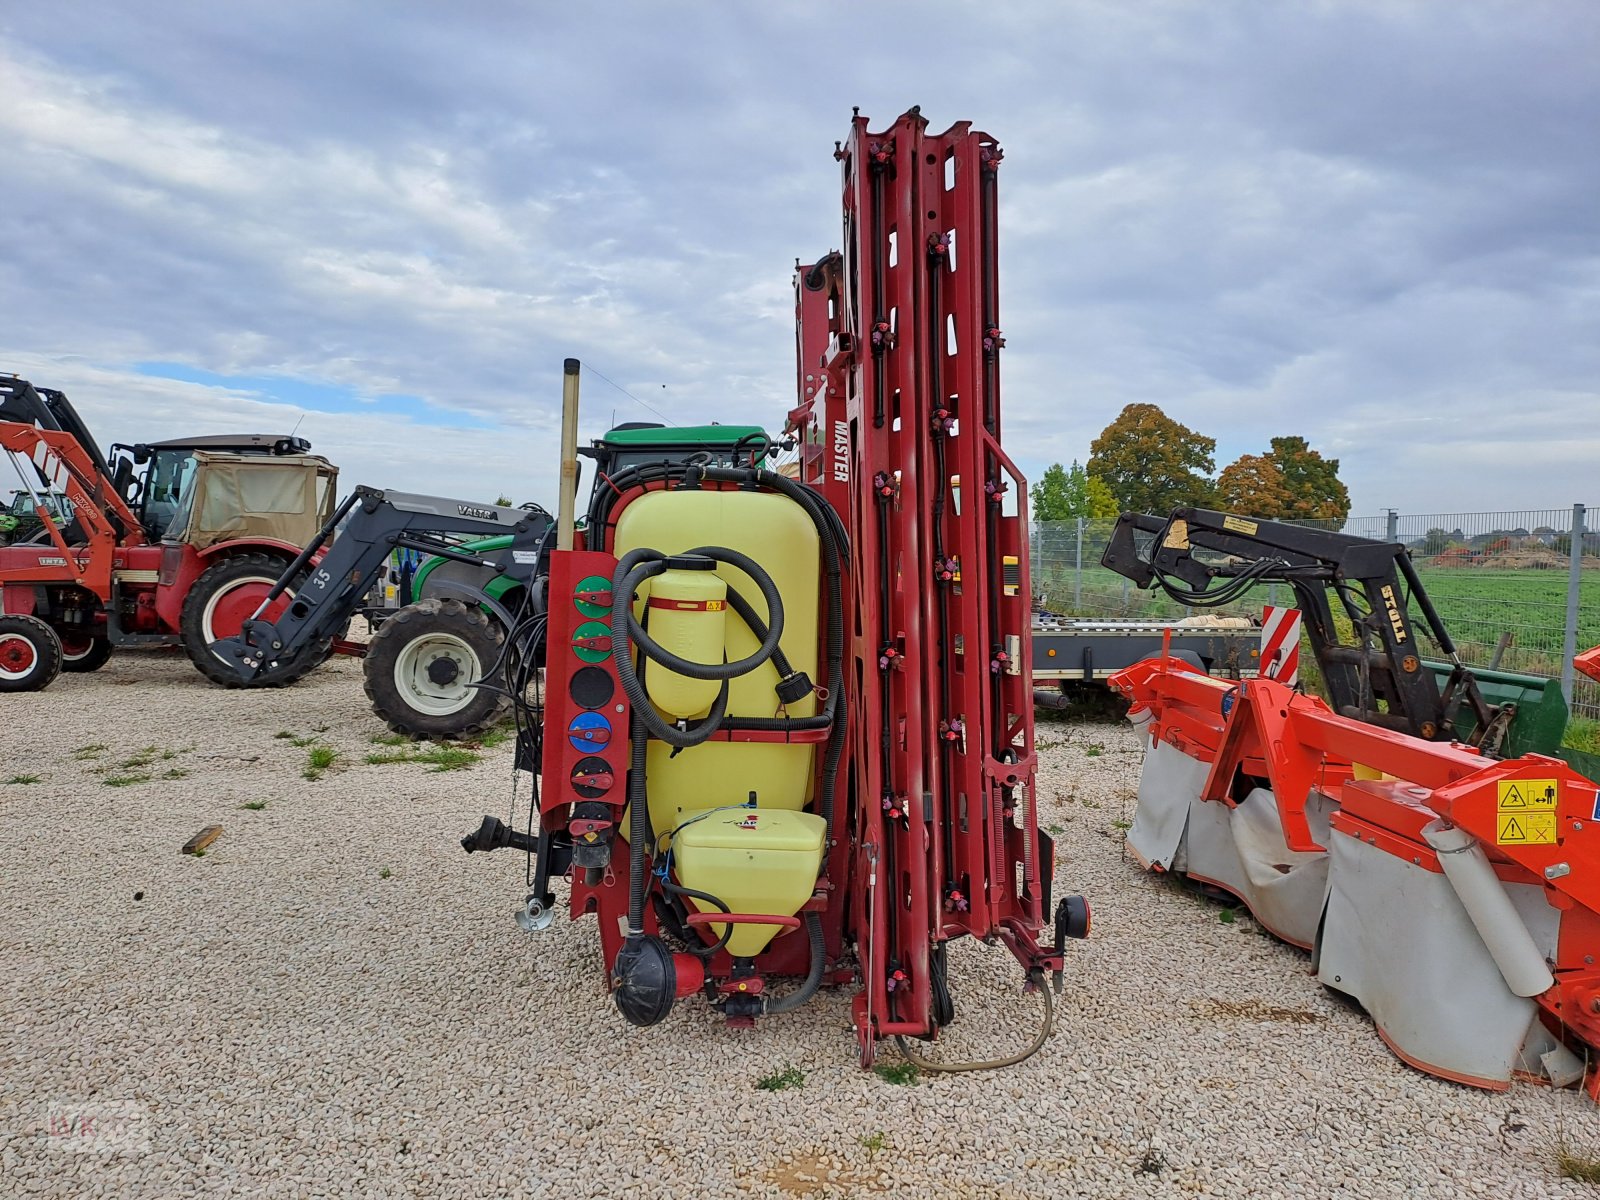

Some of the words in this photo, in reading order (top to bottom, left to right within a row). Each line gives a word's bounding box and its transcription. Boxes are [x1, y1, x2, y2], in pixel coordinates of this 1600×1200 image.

[834, 420, 849, 482] MASTER
[458, 505, 498, 521] VALTRA
[313, 568, 330, 589] 35
[1380, 584, 1407, 643] STOLL
